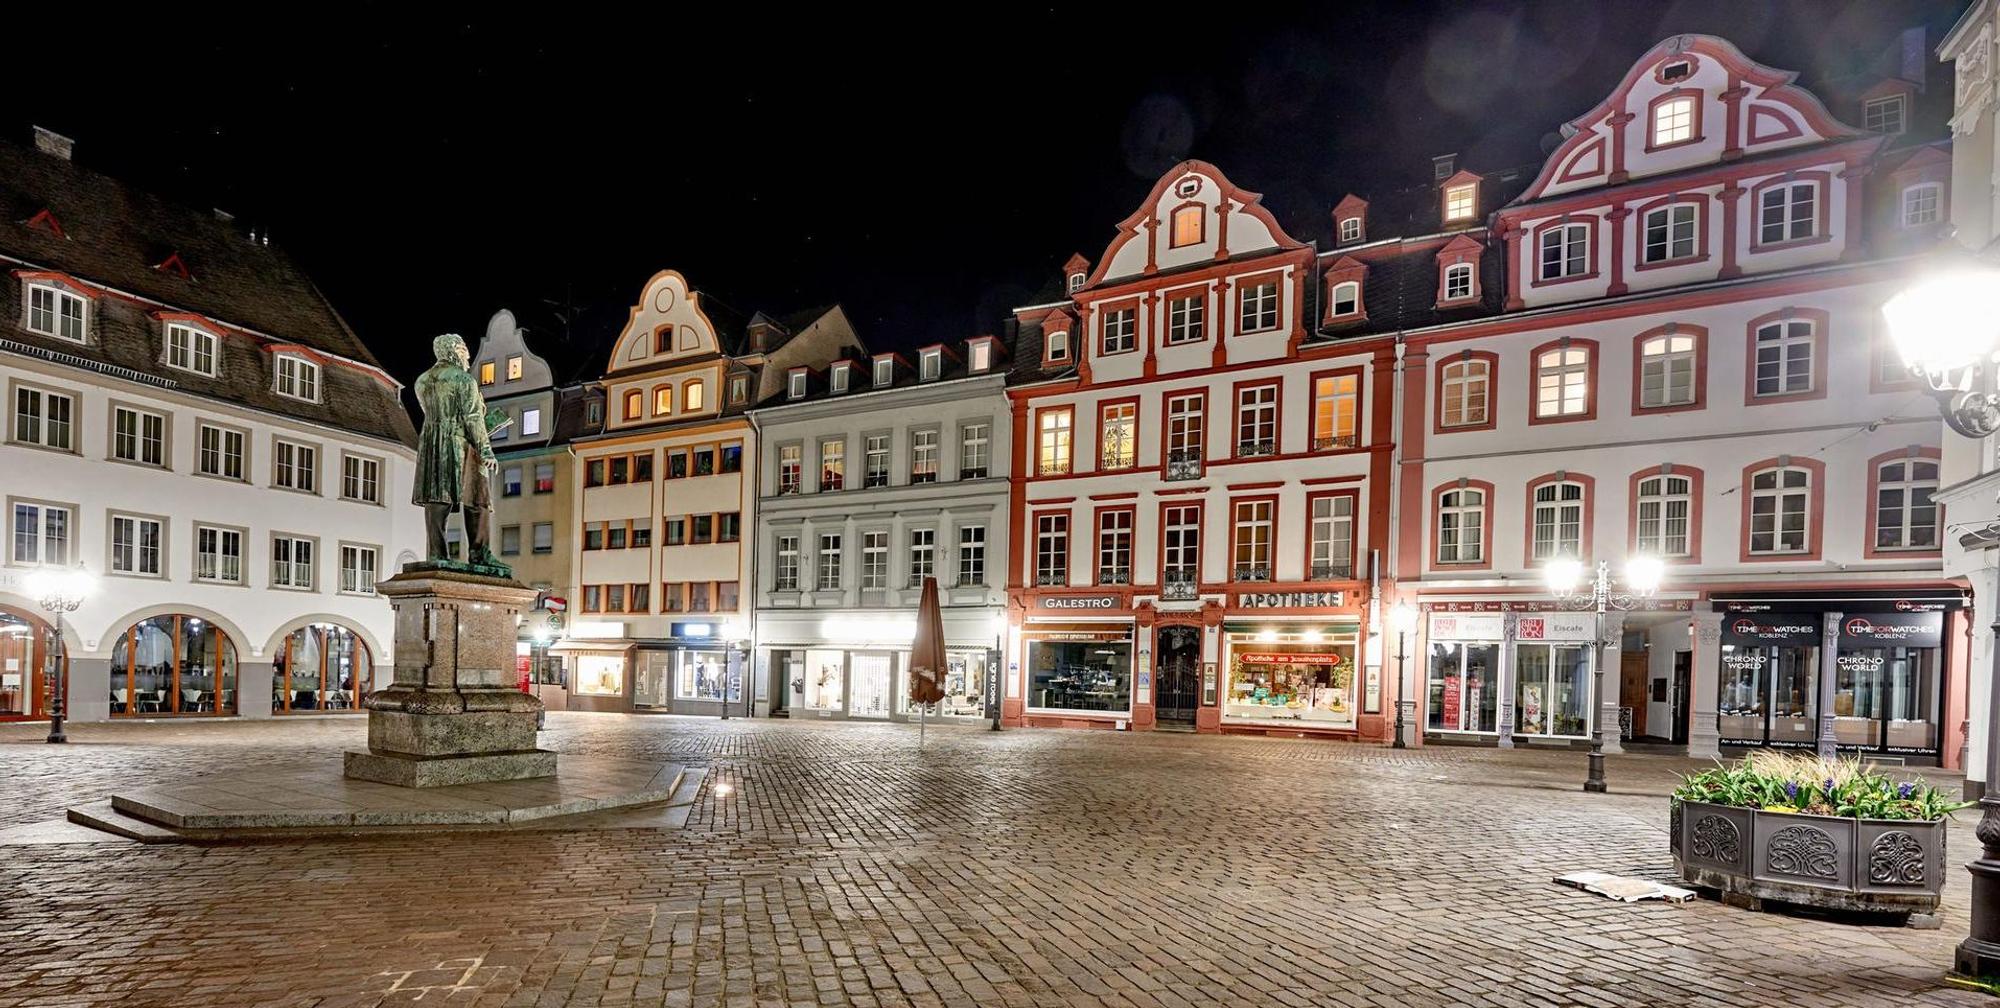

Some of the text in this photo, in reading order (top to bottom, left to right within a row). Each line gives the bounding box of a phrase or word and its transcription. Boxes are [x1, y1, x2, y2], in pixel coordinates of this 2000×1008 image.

[1045, 597, 1112, 608] GALESTRO
[1243, 592, 1339, 608] APOTHEKE
[1728, 662, 1762, 670] WORLD
